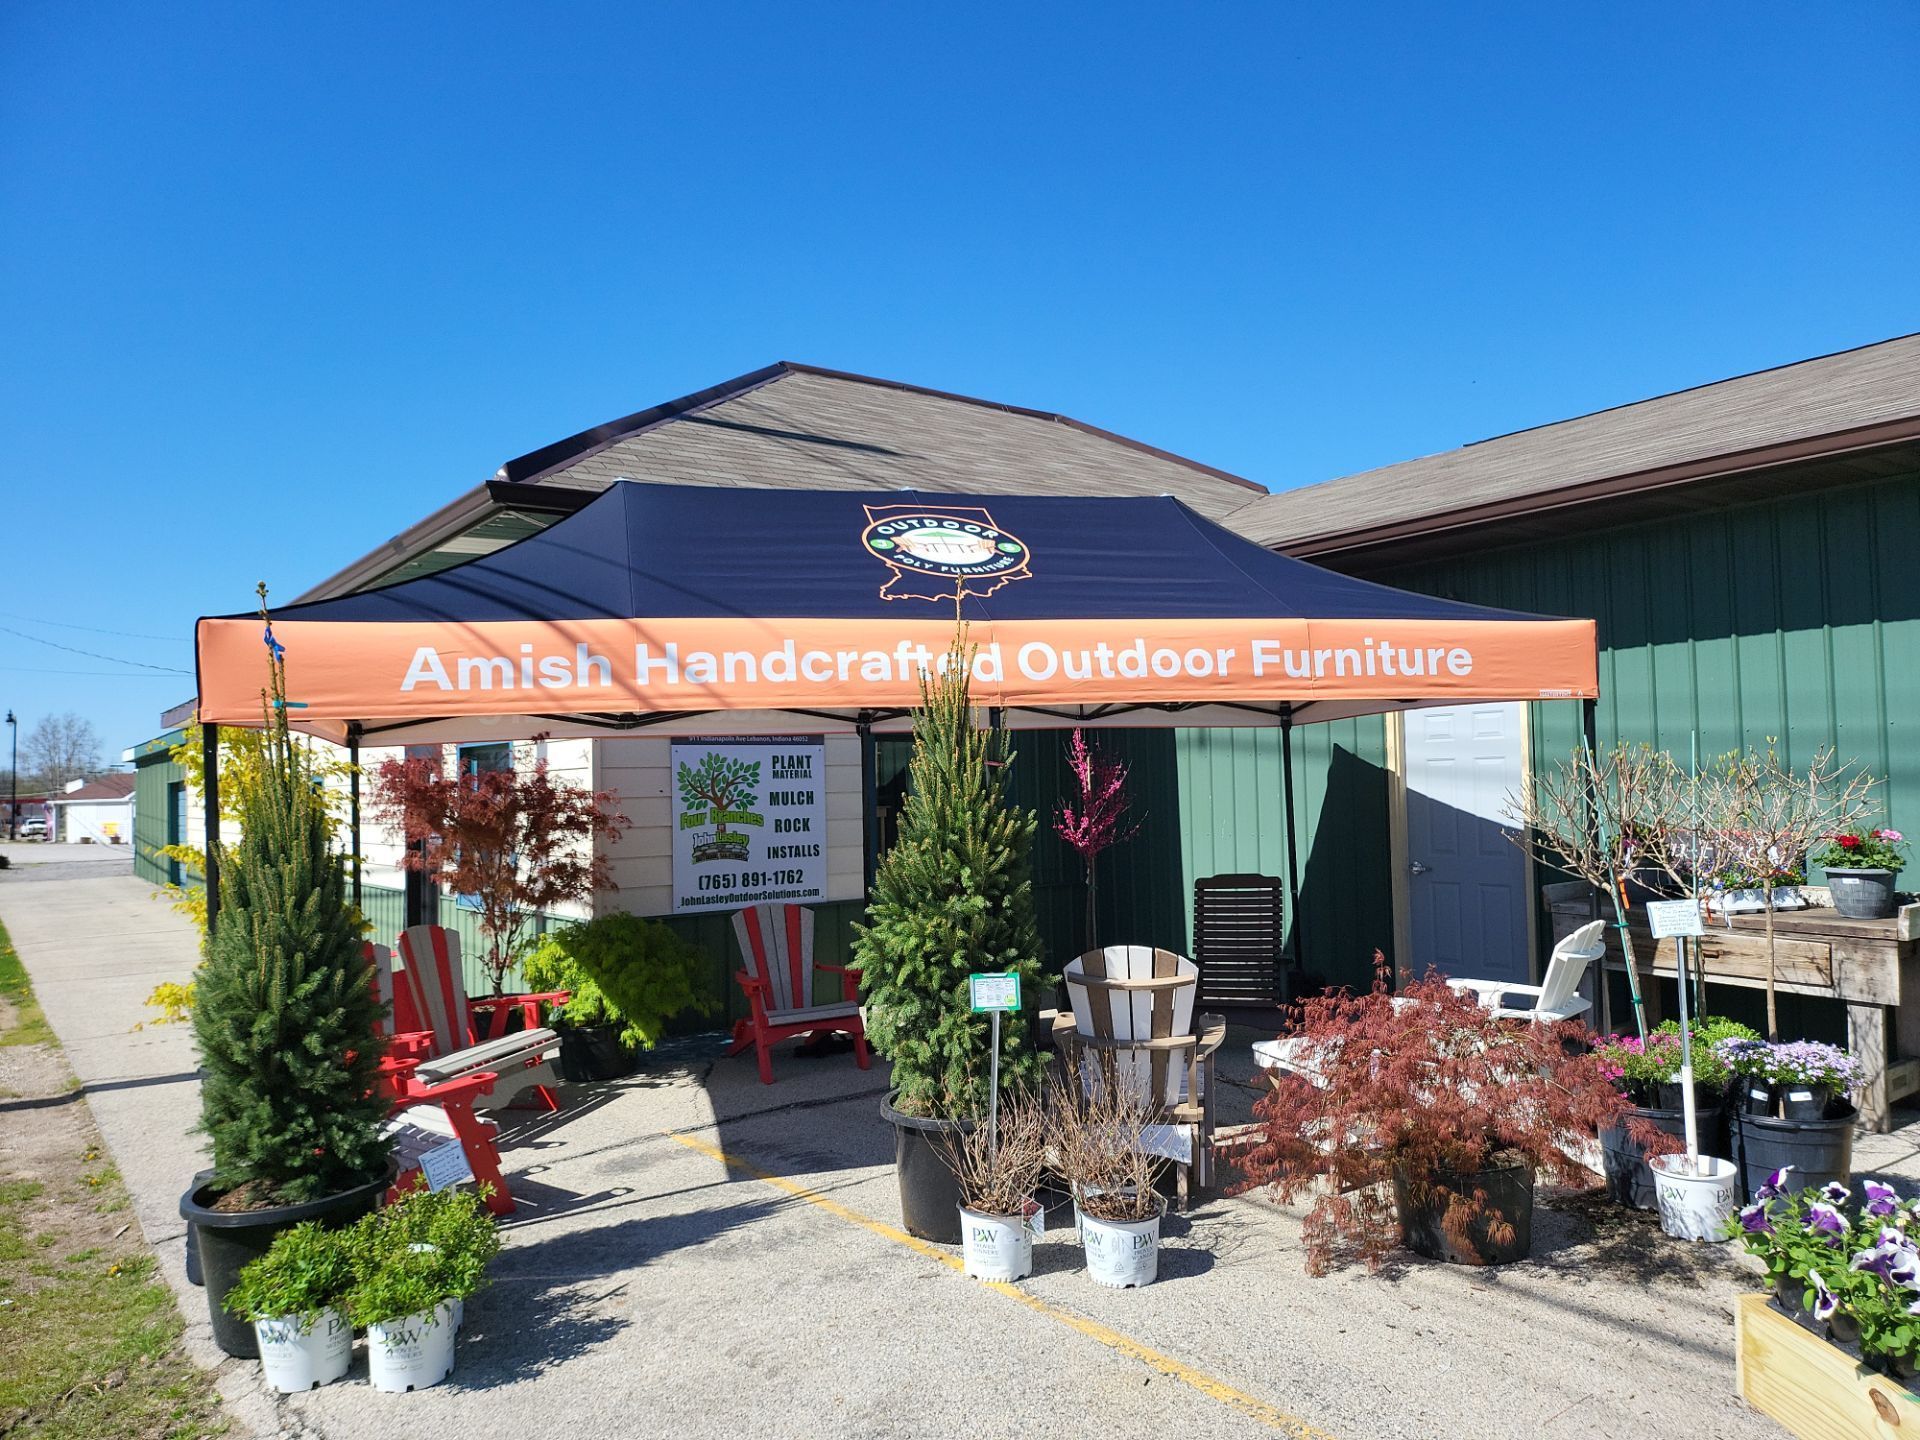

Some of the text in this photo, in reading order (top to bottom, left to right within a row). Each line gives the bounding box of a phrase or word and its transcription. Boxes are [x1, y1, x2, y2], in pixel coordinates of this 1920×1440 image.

[876, 518, 999, 539] OUTDOOR
[893, 553, 1015, 574] POLY FURNITURE
[399, 637, 1473, 691] Amish Handcrafted Outdoor Furniture
[772, 755, 812, 769] PLANT
[772, 769, 812, 780] MATERIAL
[769, 791, 814, 806] MULCH
[680, 807, 764, 831] Four Branches
[774, 817, 810, 833] ROCK
[767, 844, 820, 859] INSTALLS
[698, 869, 803, 890] (765) 891-1762
[680, 888, 820, 907] JohnLasleyOutdoorSolutions.com
[1133, 1230, 1155, 1250] PW
